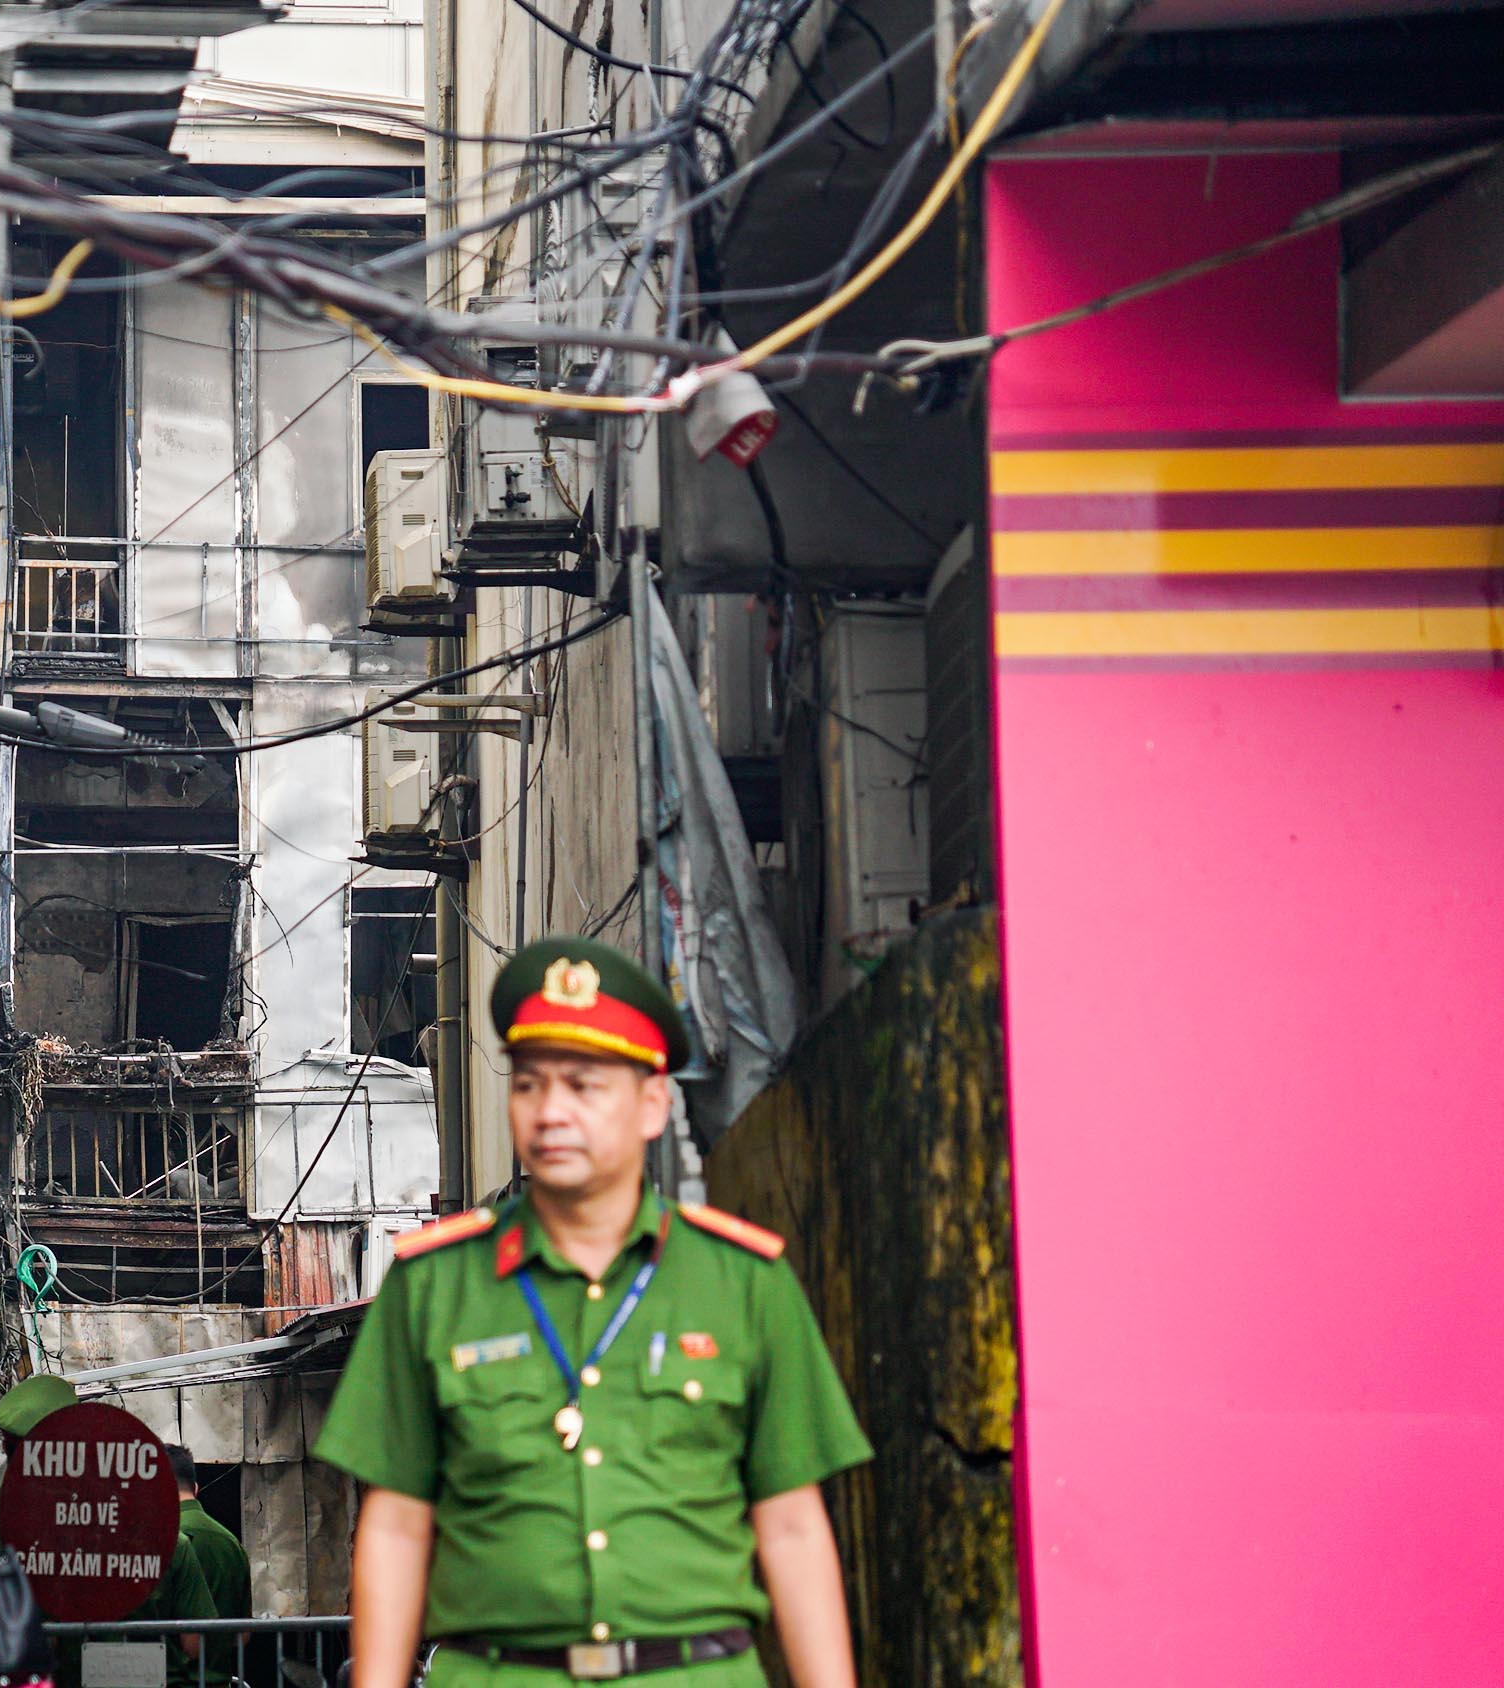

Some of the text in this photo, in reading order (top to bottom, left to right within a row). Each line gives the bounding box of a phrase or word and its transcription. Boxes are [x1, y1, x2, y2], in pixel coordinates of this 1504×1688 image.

[21, 1438, 159, 1489] KHU VỰC
[55, 1493, 120, 1533] BẢO VỆ
[59, 1547, 102, 1577] XÂM
[106, 1554, 161, 1583] PHẠM
